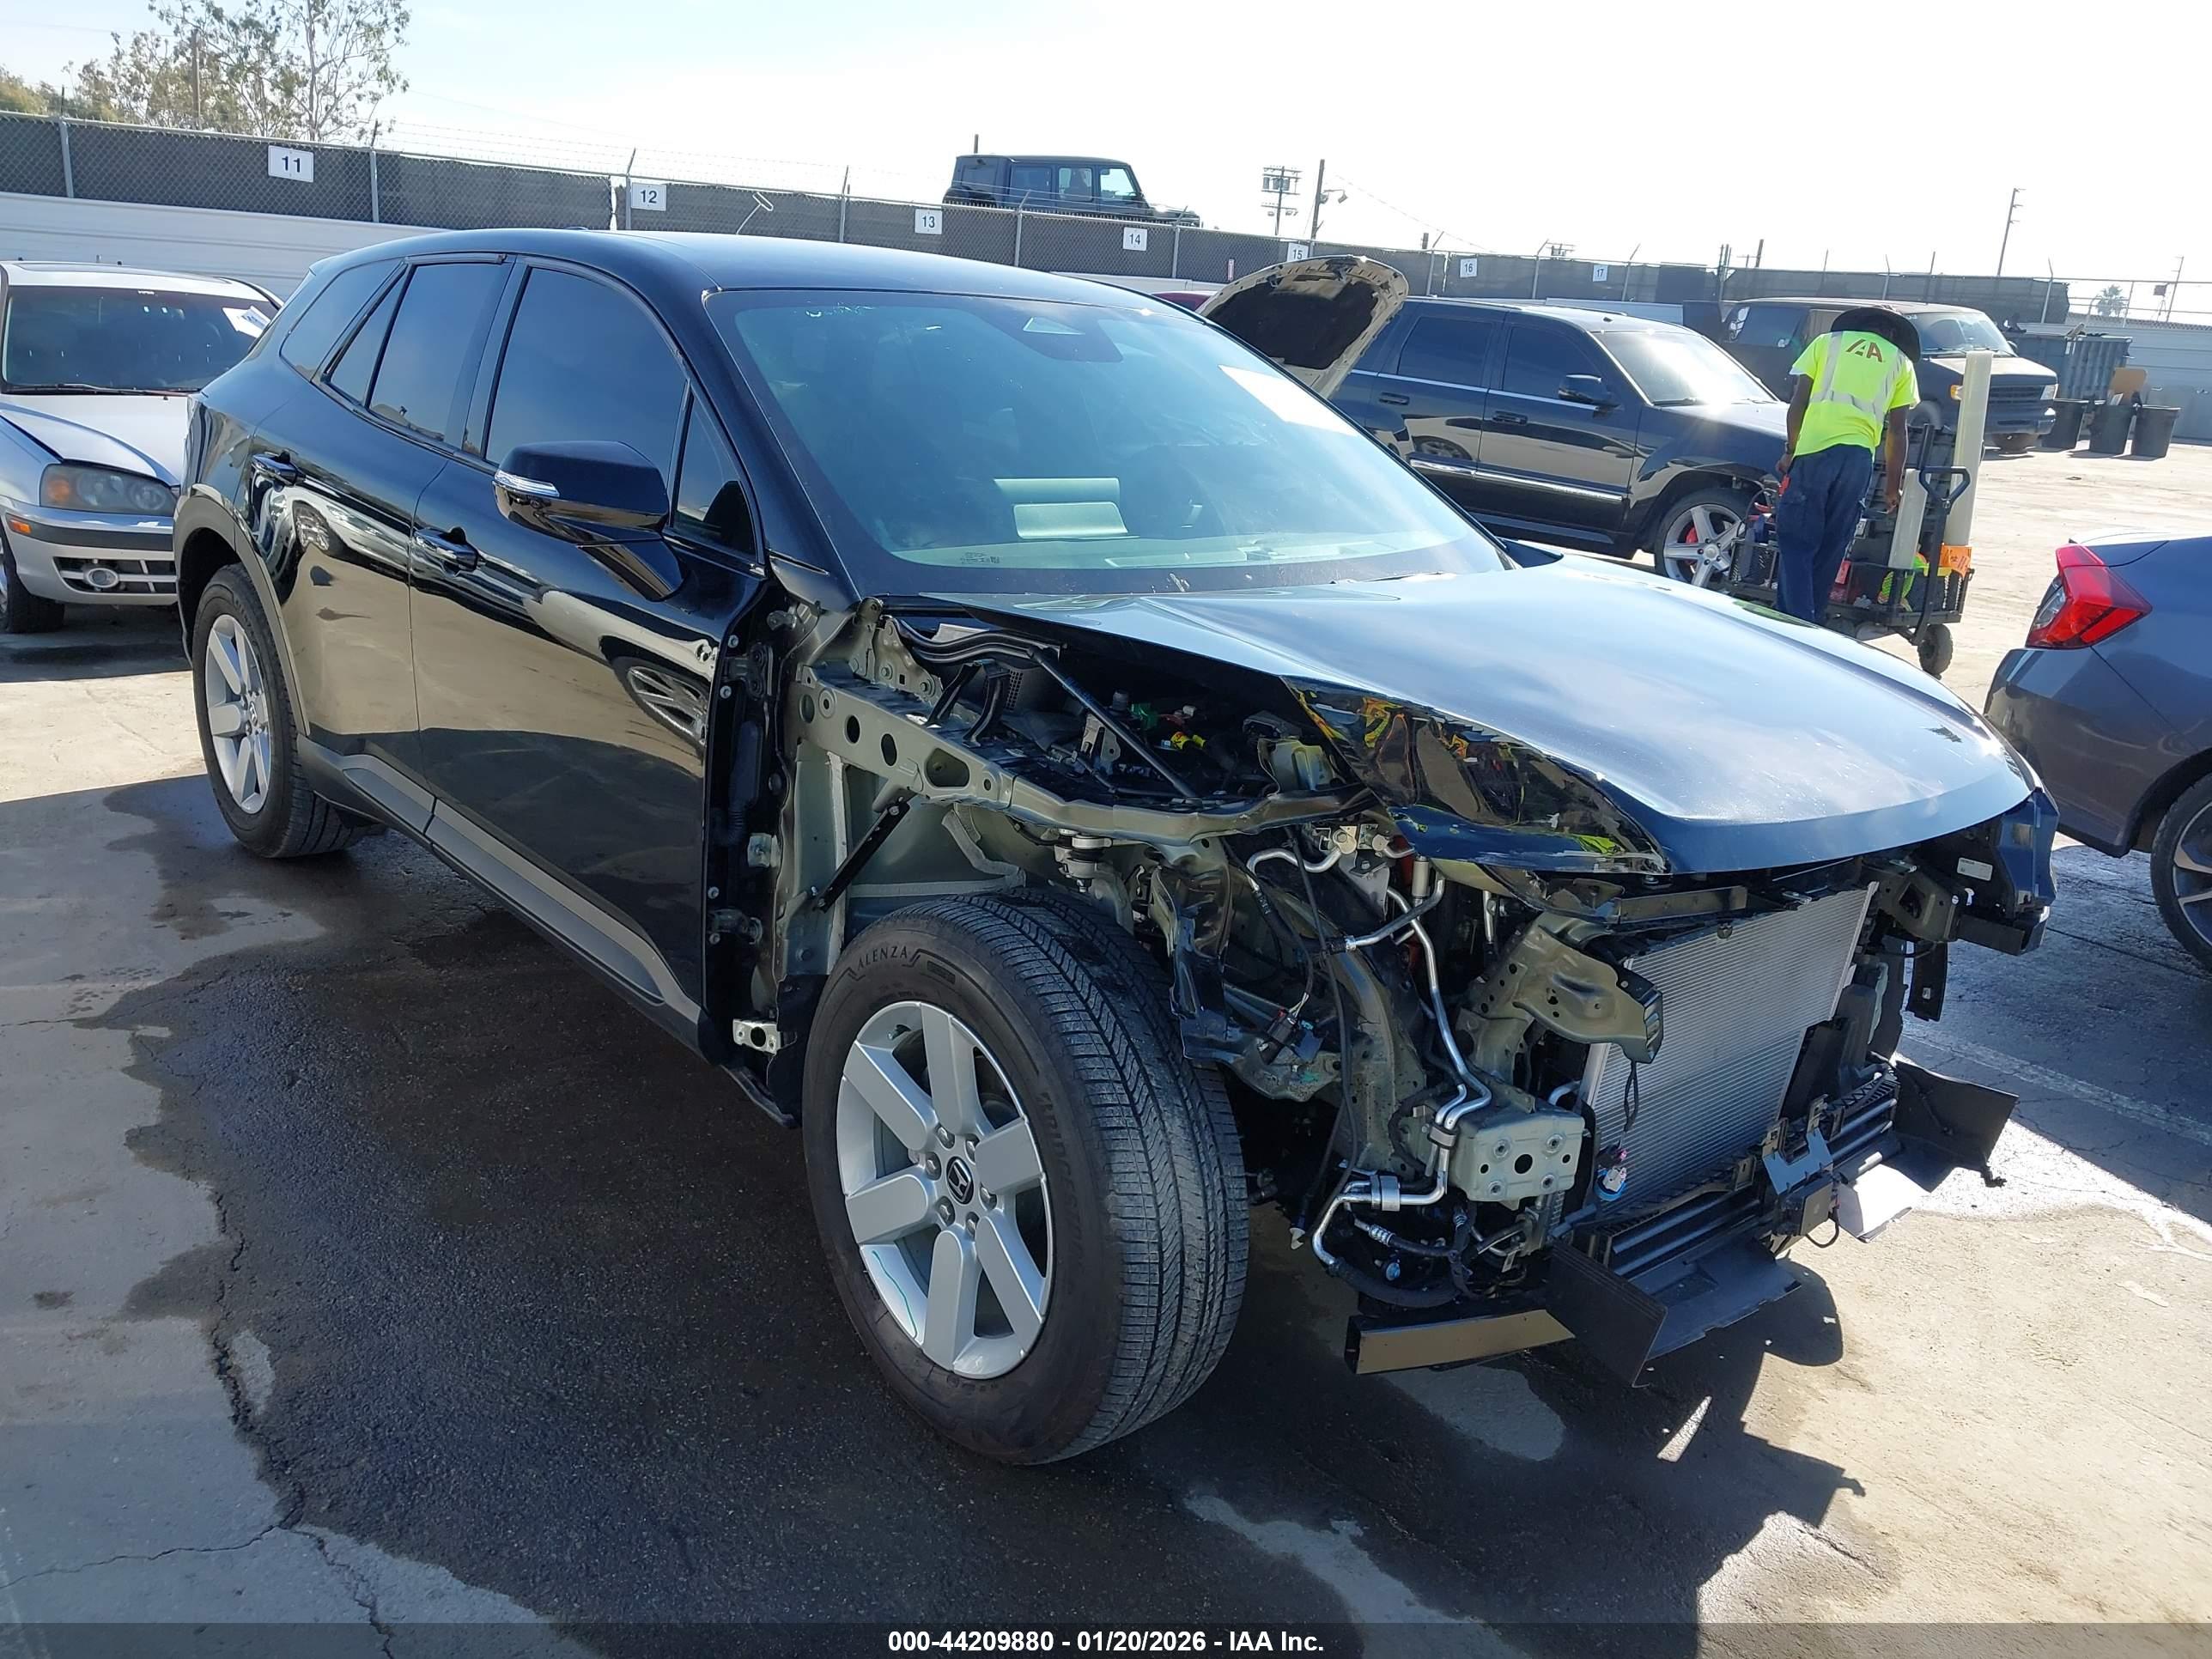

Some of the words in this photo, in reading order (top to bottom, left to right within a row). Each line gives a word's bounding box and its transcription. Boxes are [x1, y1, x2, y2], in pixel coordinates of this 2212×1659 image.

[282, 155, 301, 173] 11
[641, 190, 658, 204] 12
[921, 216, 935, 228] 13
[1129, 234, 1140, 245] 14
[1292, 249, 1303, 259] 15
[1464, 263, 1474, 273] 16
[1596, 268, 1604, 277] 17
[858, 945, 908, 970] ALENZA
